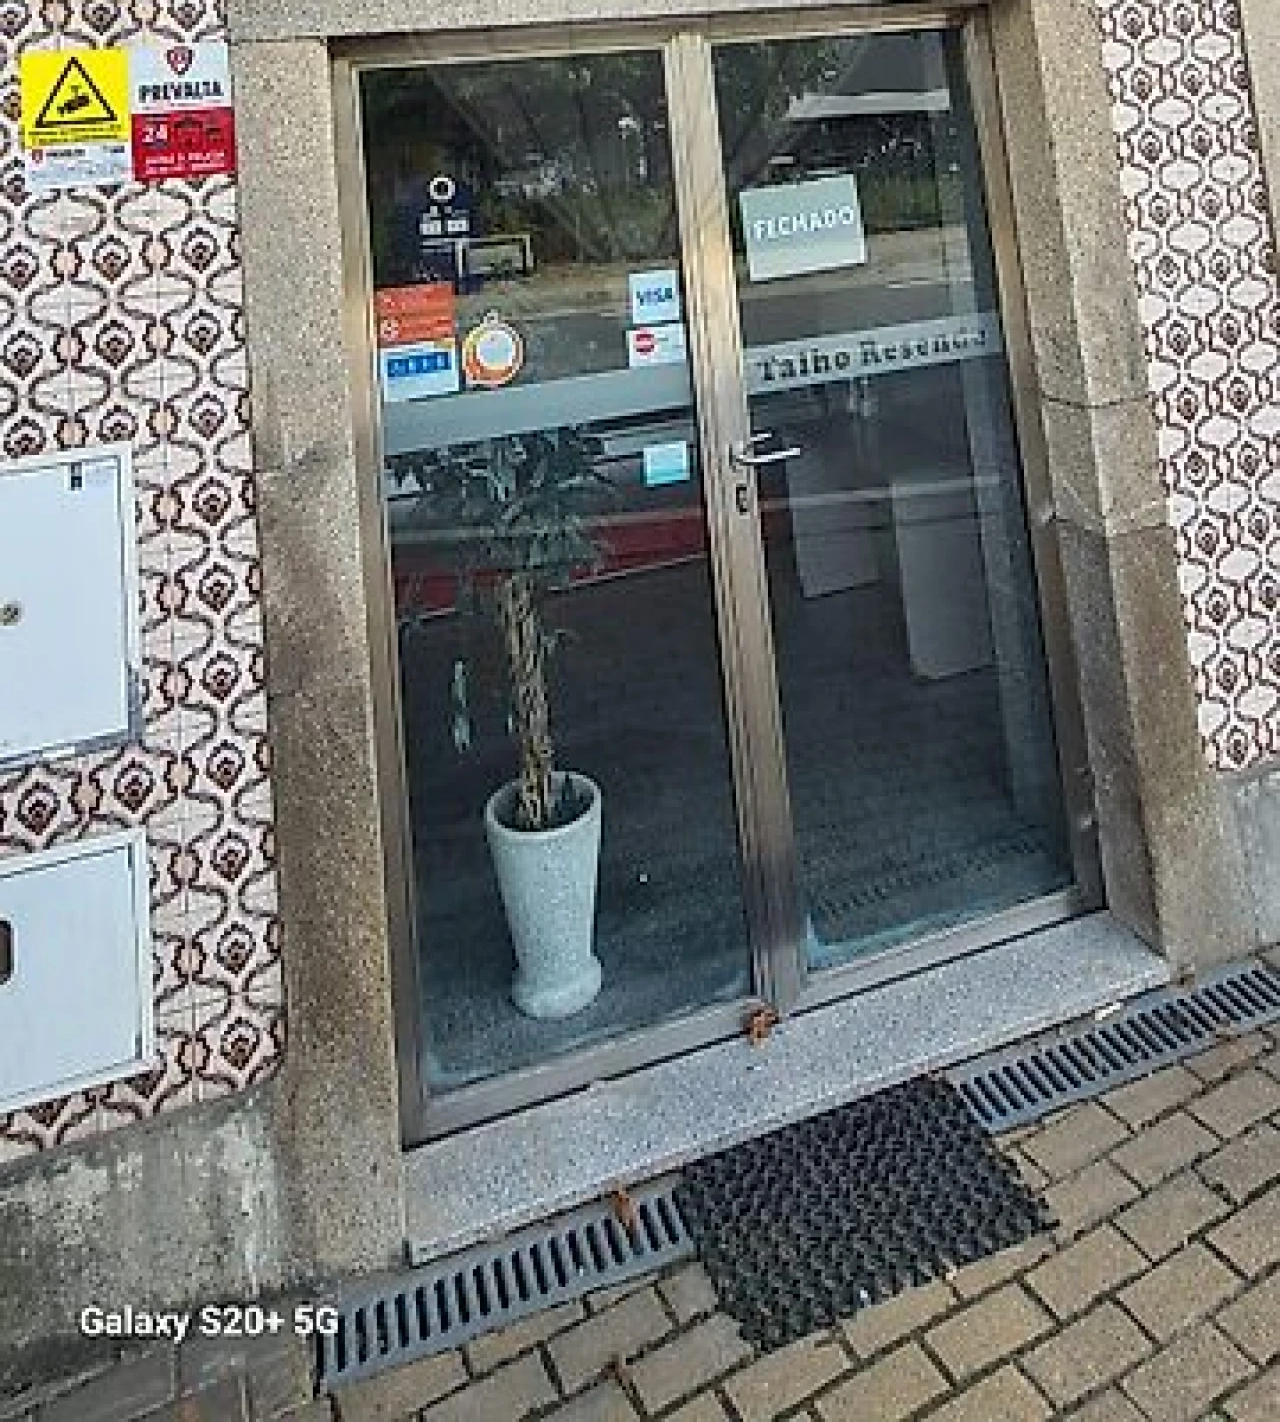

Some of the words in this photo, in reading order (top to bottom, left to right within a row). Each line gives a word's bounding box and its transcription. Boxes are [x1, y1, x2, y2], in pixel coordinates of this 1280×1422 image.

[138, 80, 224, 103] PREVALTA
[143, 124, 169, 144] 24
[753, 205, 855, 240] FECHADO
[636, 286, 673, 306] VISA
[757, 347, 852, 381] Talho
